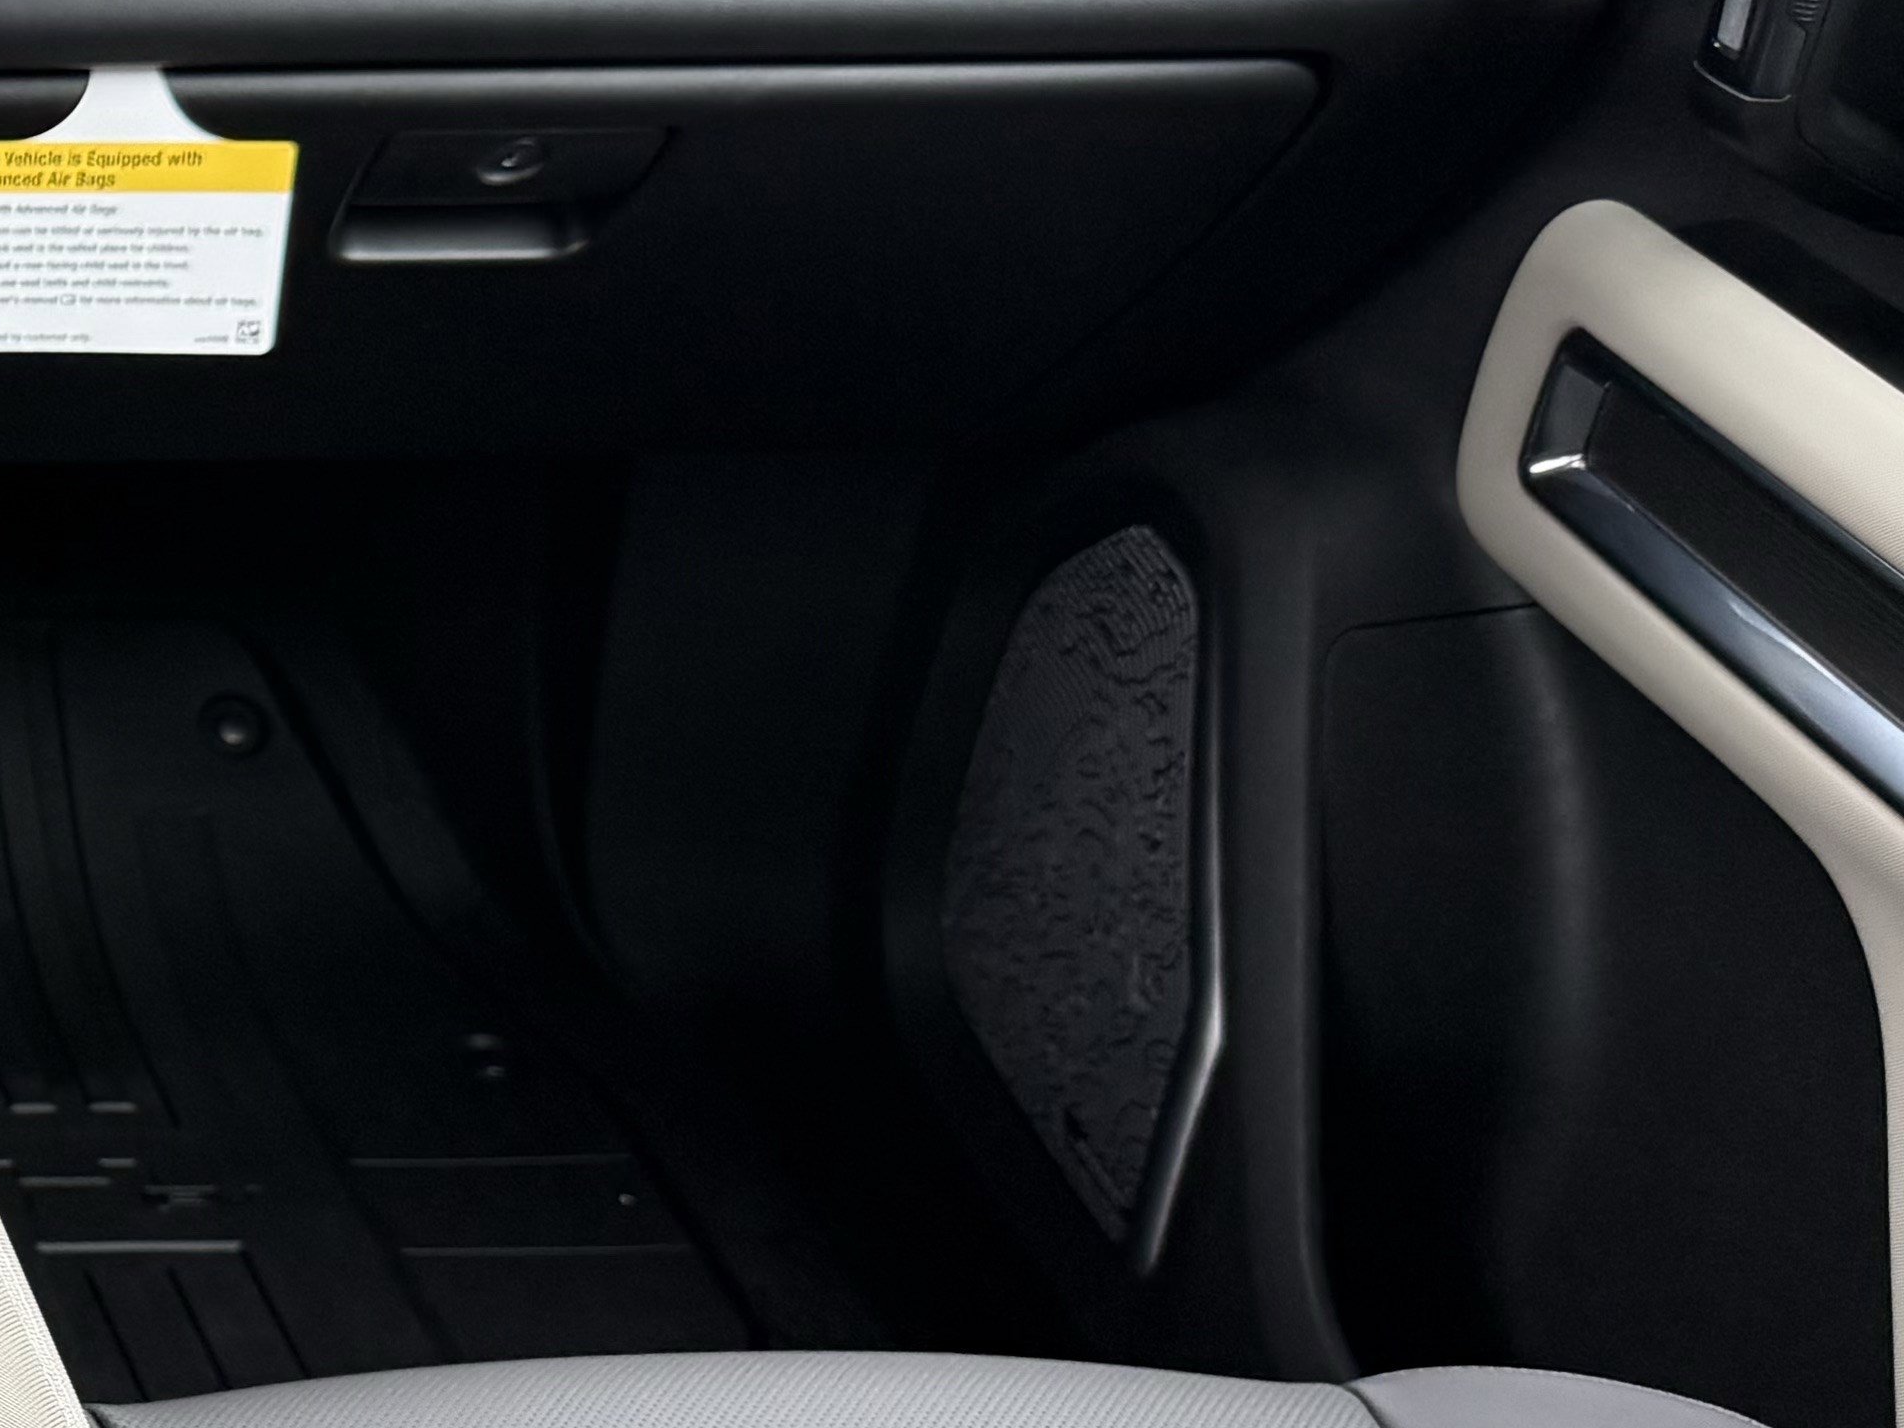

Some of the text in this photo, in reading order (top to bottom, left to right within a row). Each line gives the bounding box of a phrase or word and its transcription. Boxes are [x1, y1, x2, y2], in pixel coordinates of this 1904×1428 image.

[4, 151, 62, 167] Vehicle
[67, 151, 81, 167] is
[85, 151, 162, 170] Equipped
[167, 151, 203, 167] with
[46, 171, 72, 187] Air
[75, 172, 116, 190] Bags
